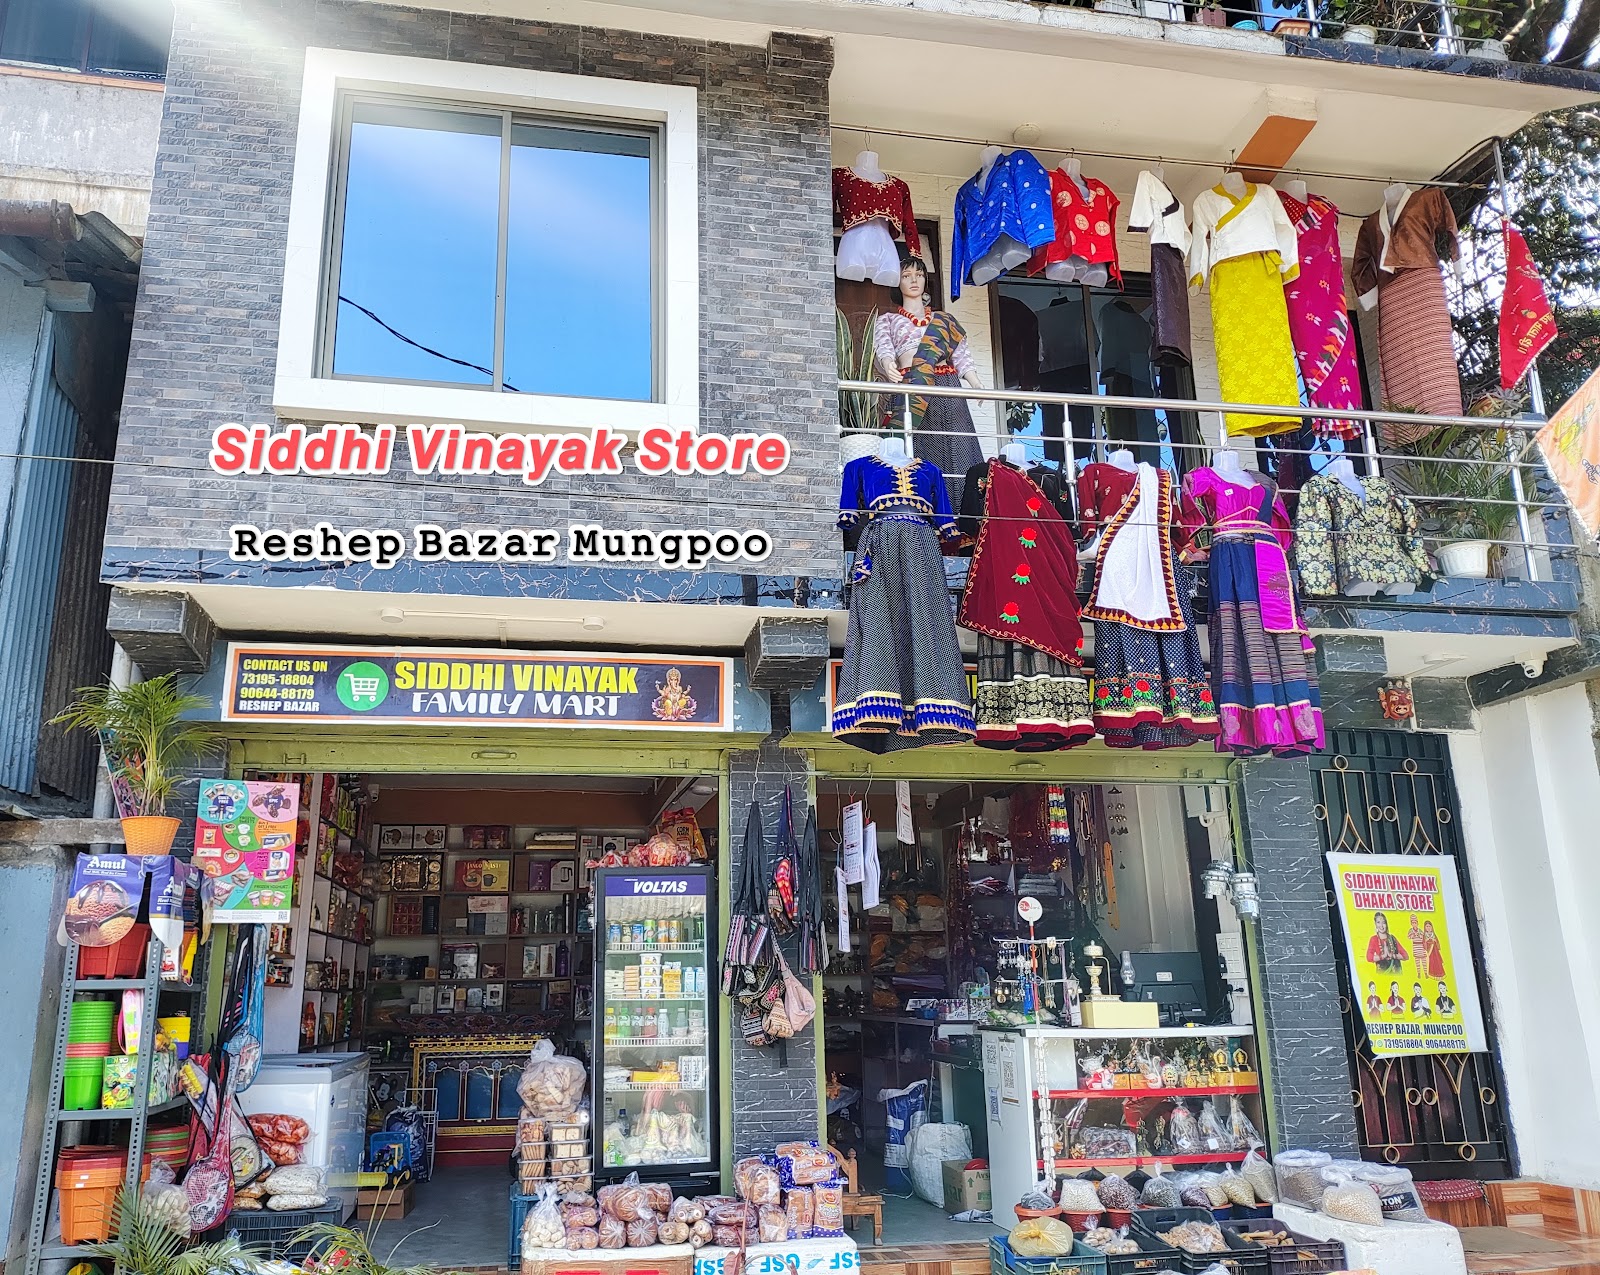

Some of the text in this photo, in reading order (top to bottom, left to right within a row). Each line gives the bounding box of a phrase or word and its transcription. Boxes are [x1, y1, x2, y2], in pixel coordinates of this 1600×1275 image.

[242, 658, 328, 673] CONTACT US ON
[241, 672, 315, 686] 73195-18804
[394, 660, 639, 694] SIDDHI VINAYAK
[239, 686, 315, 700] 90644-88179
[238, 699, 320, 712] RESHEP BAZAR
[410, 690, 622, 717] FAMILY MART
[86, 855, 127, 870] Amul
[633, 880, 688, 894] VOLTAS
[1343, 872, 1438, 892] SIDDHI VINAYAK
[1353, 891, 1434, 911] DHAKA STORE
[1366, 1023, 1464, 1036] RESHEP BAZAR, MUNGPOO
[975, 1171, 990, 1179] Avs
[759, 1252, 801, 1274] GSF
